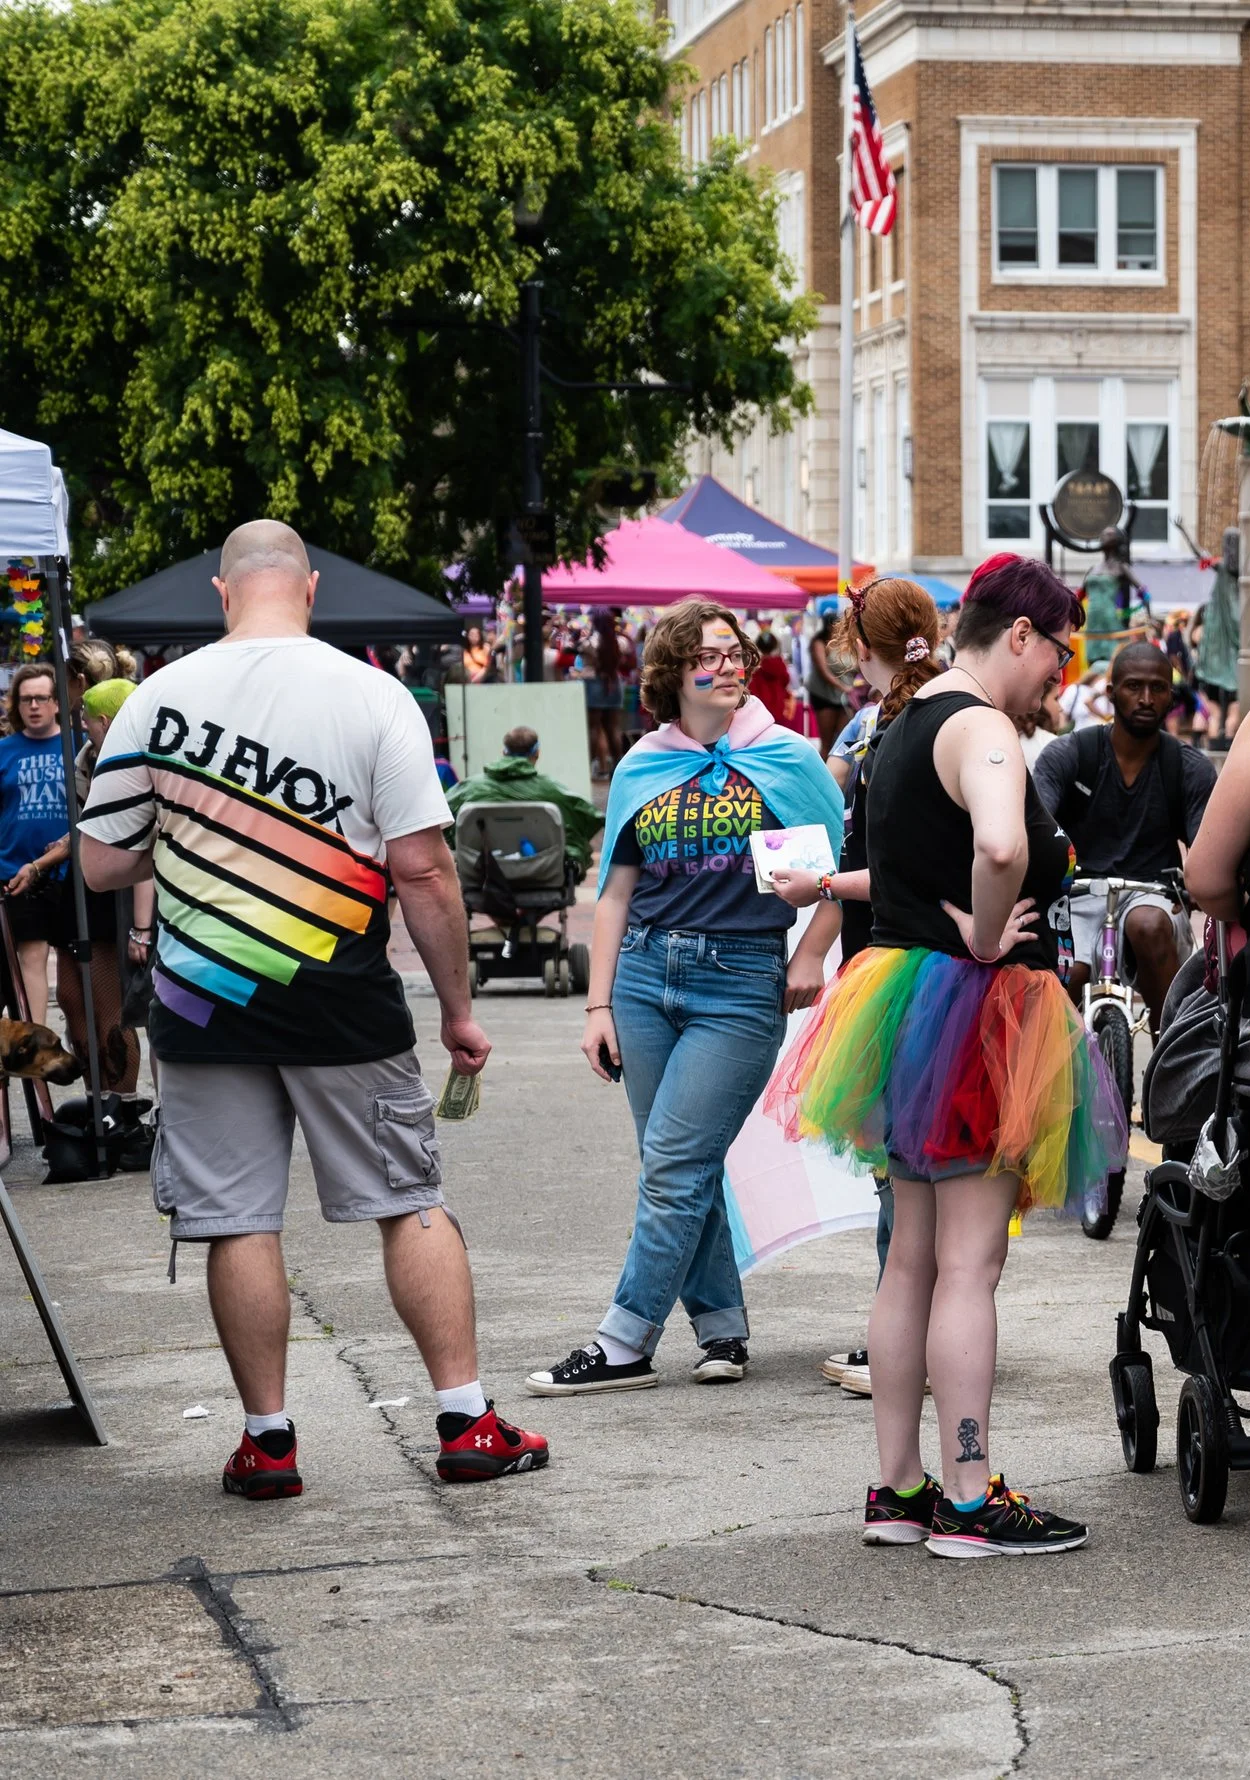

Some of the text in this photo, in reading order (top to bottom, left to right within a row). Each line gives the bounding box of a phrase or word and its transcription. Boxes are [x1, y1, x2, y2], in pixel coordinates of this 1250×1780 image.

[147, 706, 226, 768] DJ
[18, 753, 57, 770] THE
[17, 767, 65, 785] MUSI
[686, 792, 701, 804] IS
[683, 807, 698, 820] IS
[702, 801, 762, 819] LOVE
[683, 825, 697, 838] IS
[702, 818, 762, 837] LOVE
[683, 844, 698, 857] IS
[702, 836, 753, 855] LOV
[685, 861, 700, 875] IS
